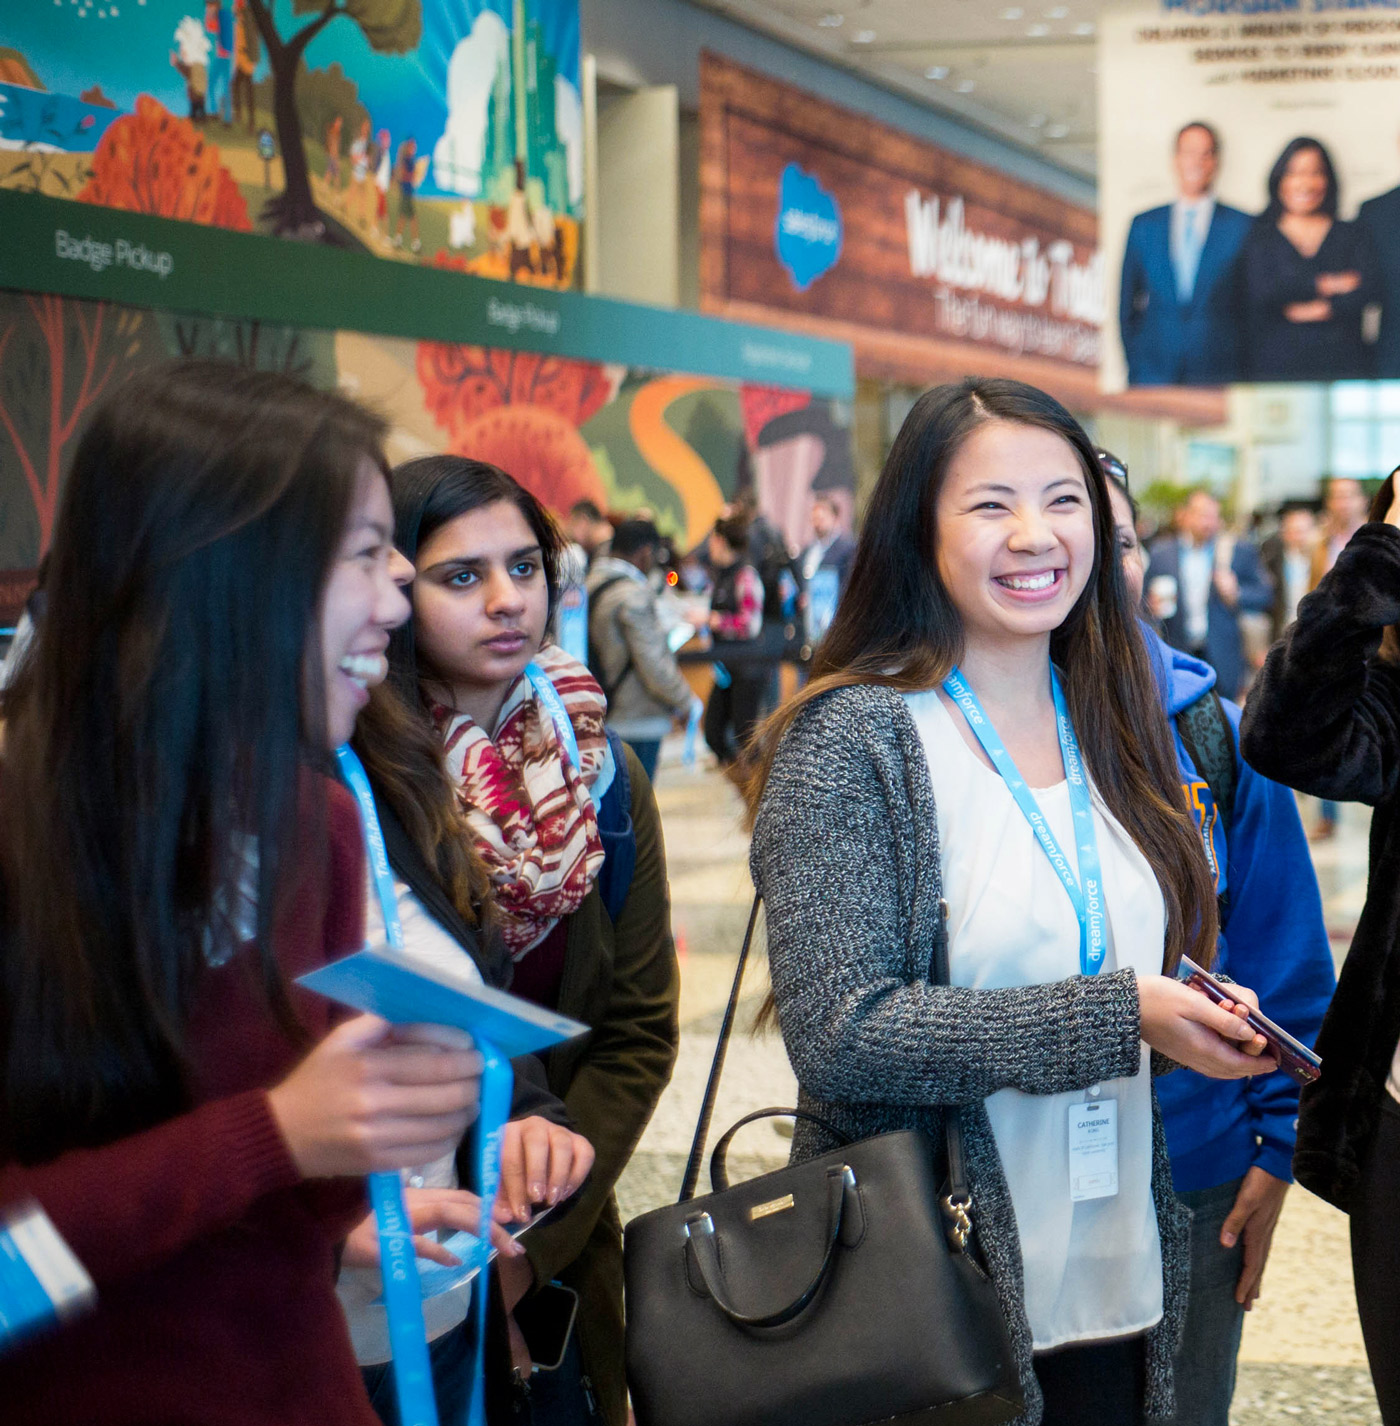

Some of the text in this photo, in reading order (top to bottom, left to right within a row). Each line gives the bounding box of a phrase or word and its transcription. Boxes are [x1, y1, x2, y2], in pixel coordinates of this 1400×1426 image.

[55, 229, 174, 280] Badge Pickup
[536, 676, 572, 740] dreamforce
[947, 674, 983, 725] amforce
[1058, 713, 1083, 786] dreamforce
[1029, 811, 1074, 887] dreamforce
[1088, 878, 1101, 962] dreamforce
[1077, 1117, 1110, 1129] CATHERINE
